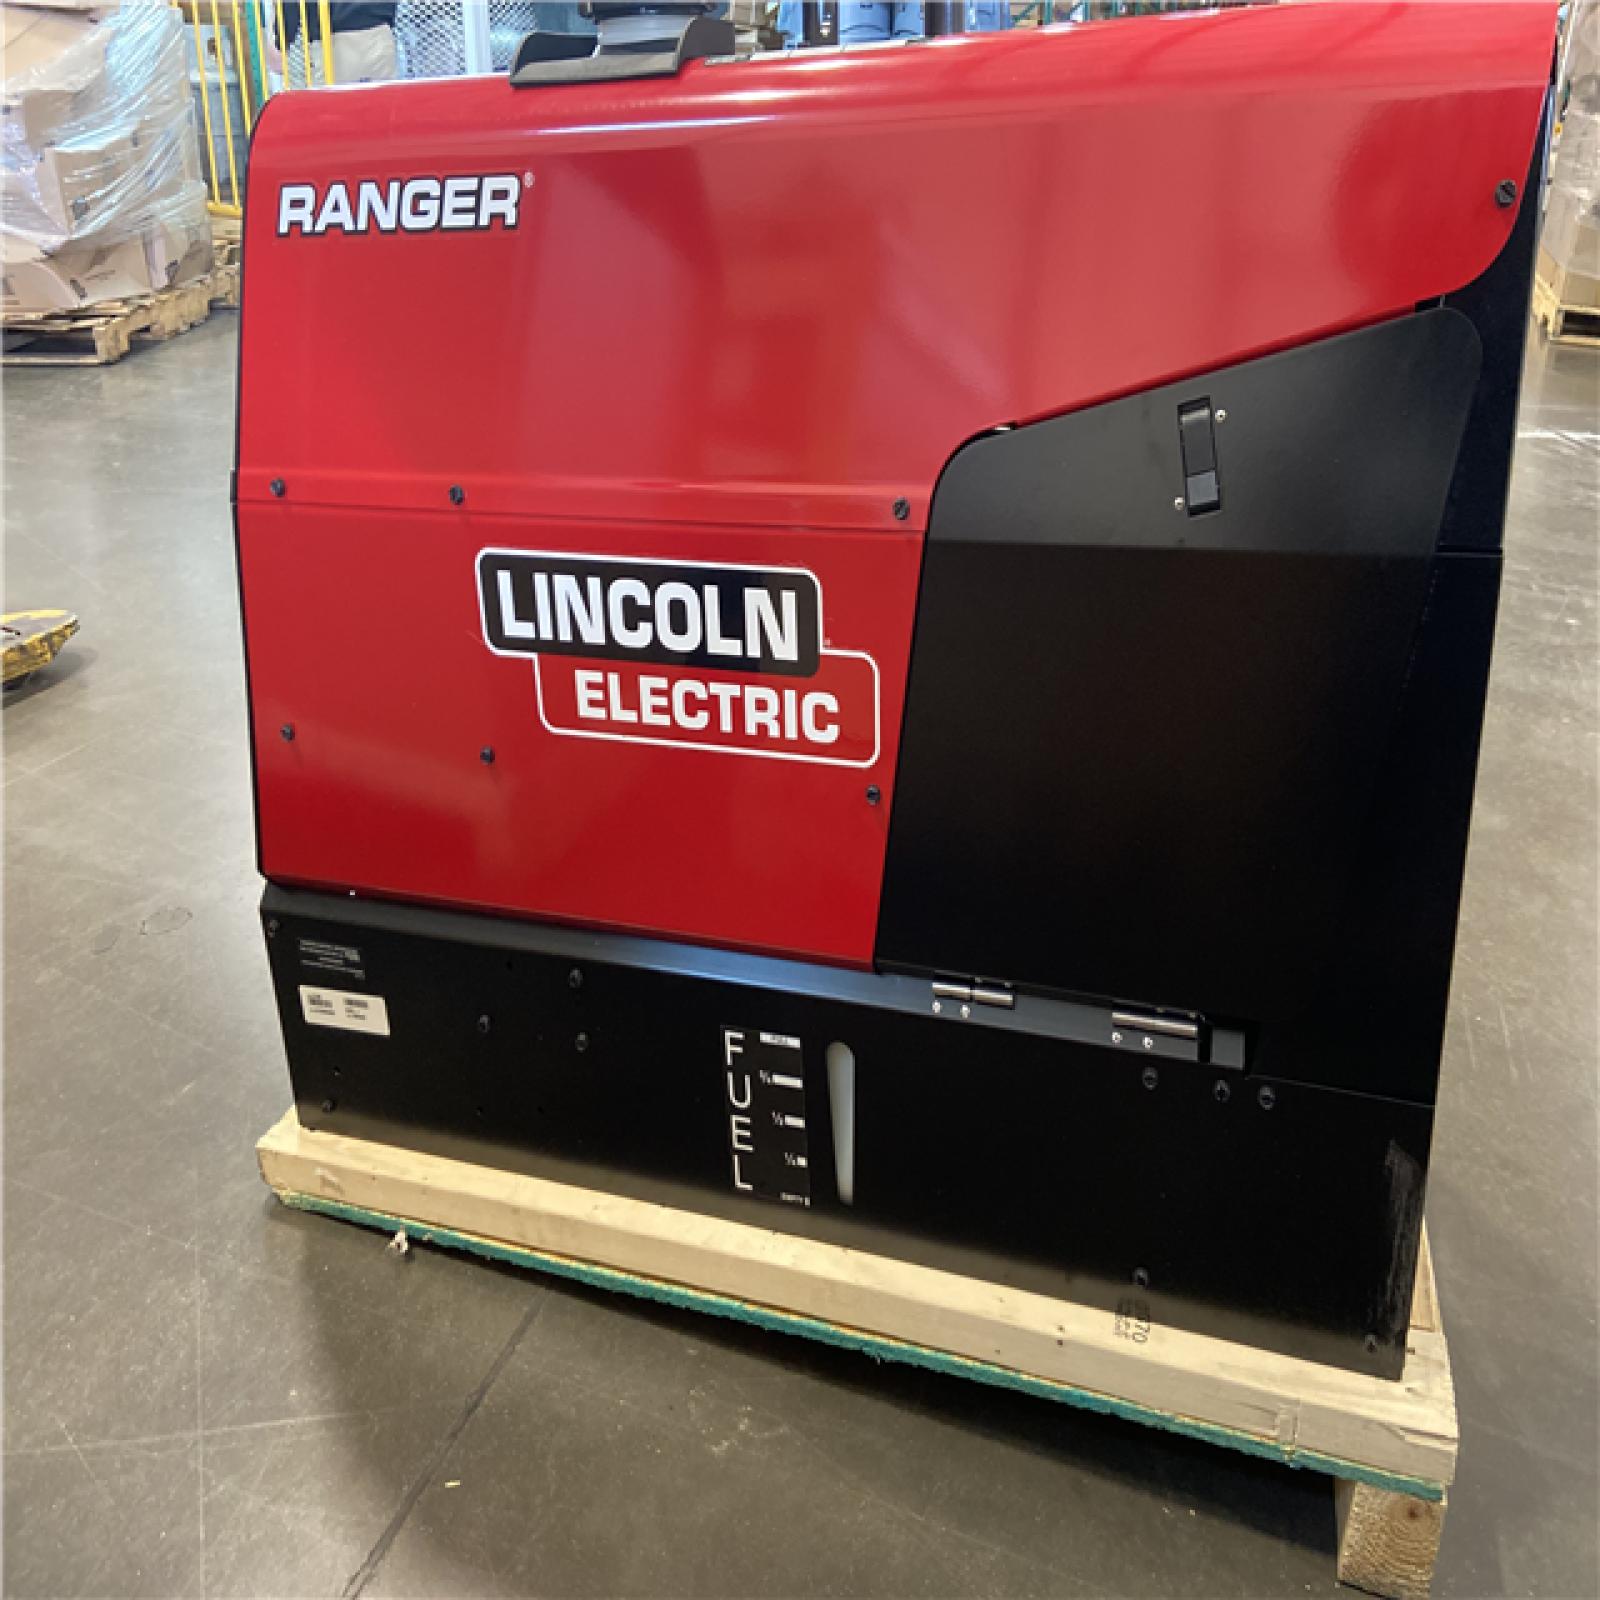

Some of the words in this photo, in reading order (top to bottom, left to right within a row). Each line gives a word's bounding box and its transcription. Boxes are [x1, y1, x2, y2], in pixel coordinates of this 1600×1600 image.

[497, 570, 799, 661] LINCOLN
[574, 669, 840, 744] ELECTRIC
[724, 1029, 754, 1191] FUEL
